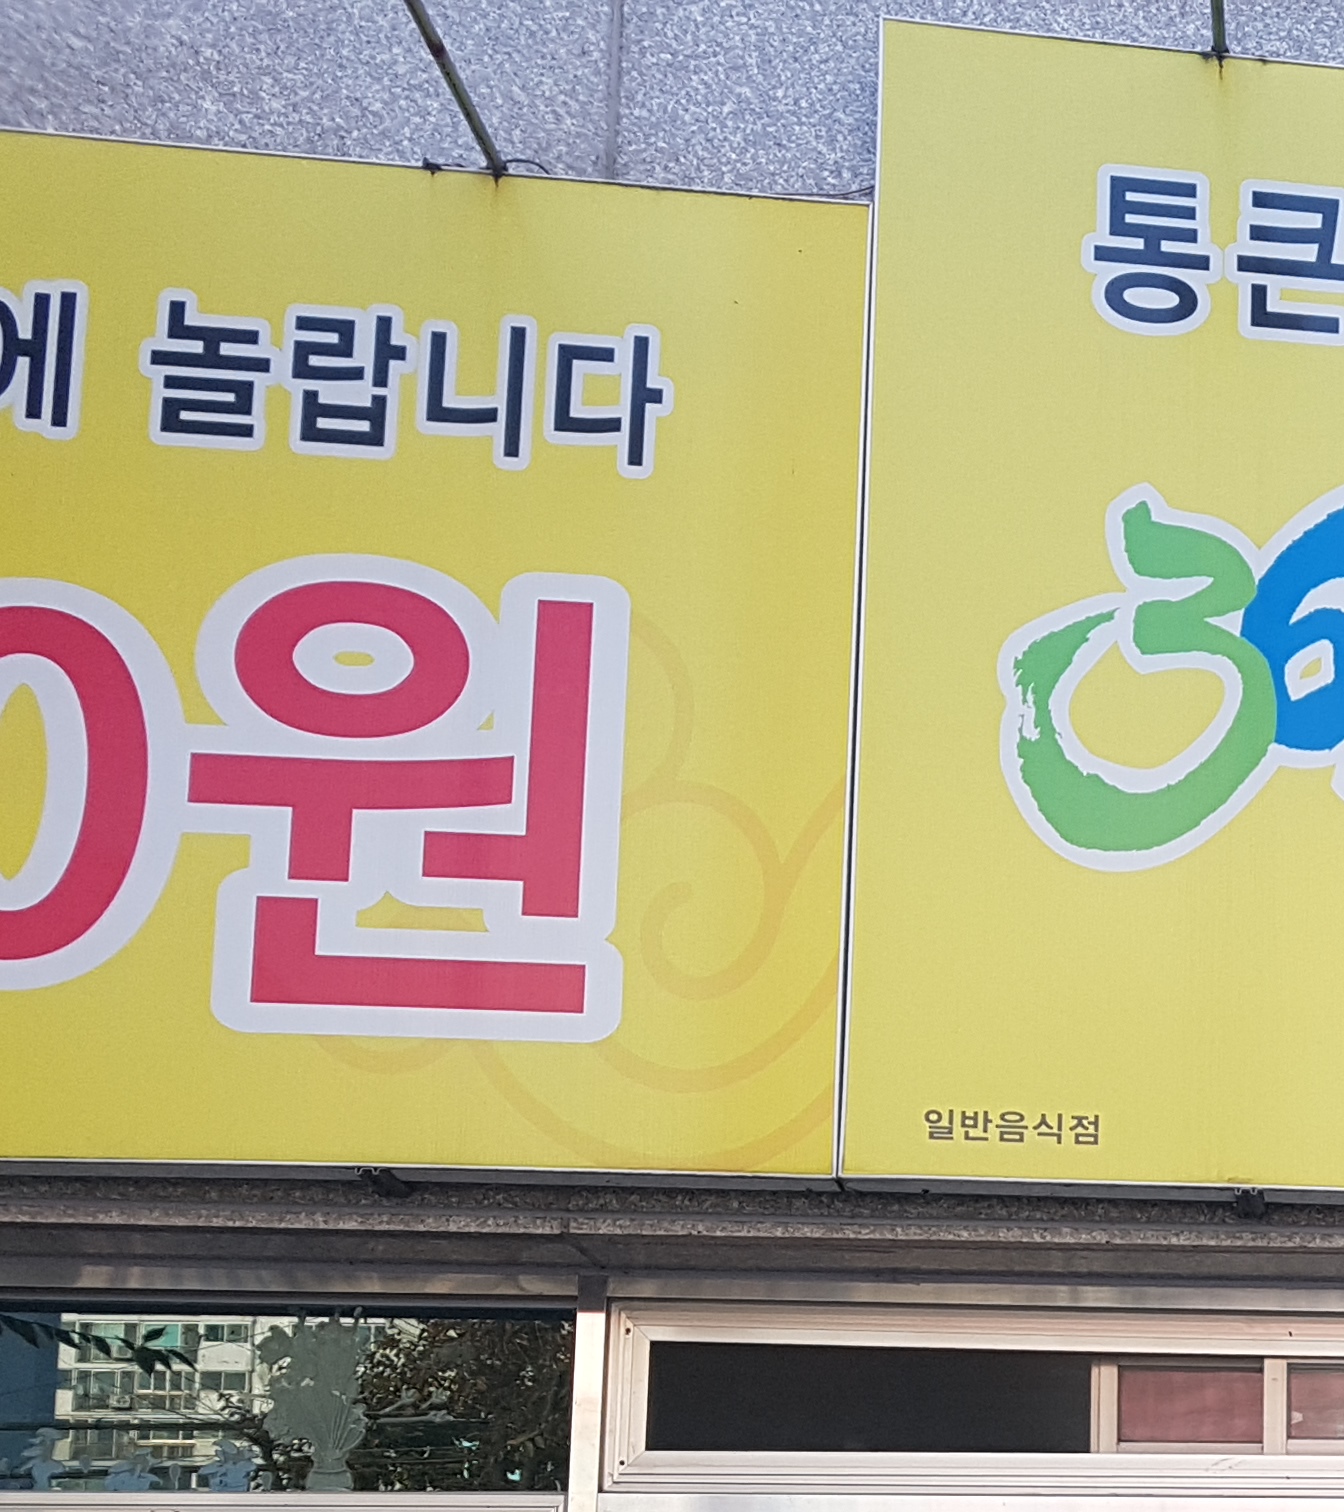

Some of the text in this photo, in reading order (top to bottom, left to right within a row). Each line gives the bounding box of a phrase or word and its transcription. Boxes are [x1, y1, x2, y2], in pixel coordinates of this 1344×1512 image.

[0, 290, 664, 467] 에 놀랍니다
[923, 1108, 1101, 1146] 일반음식점
